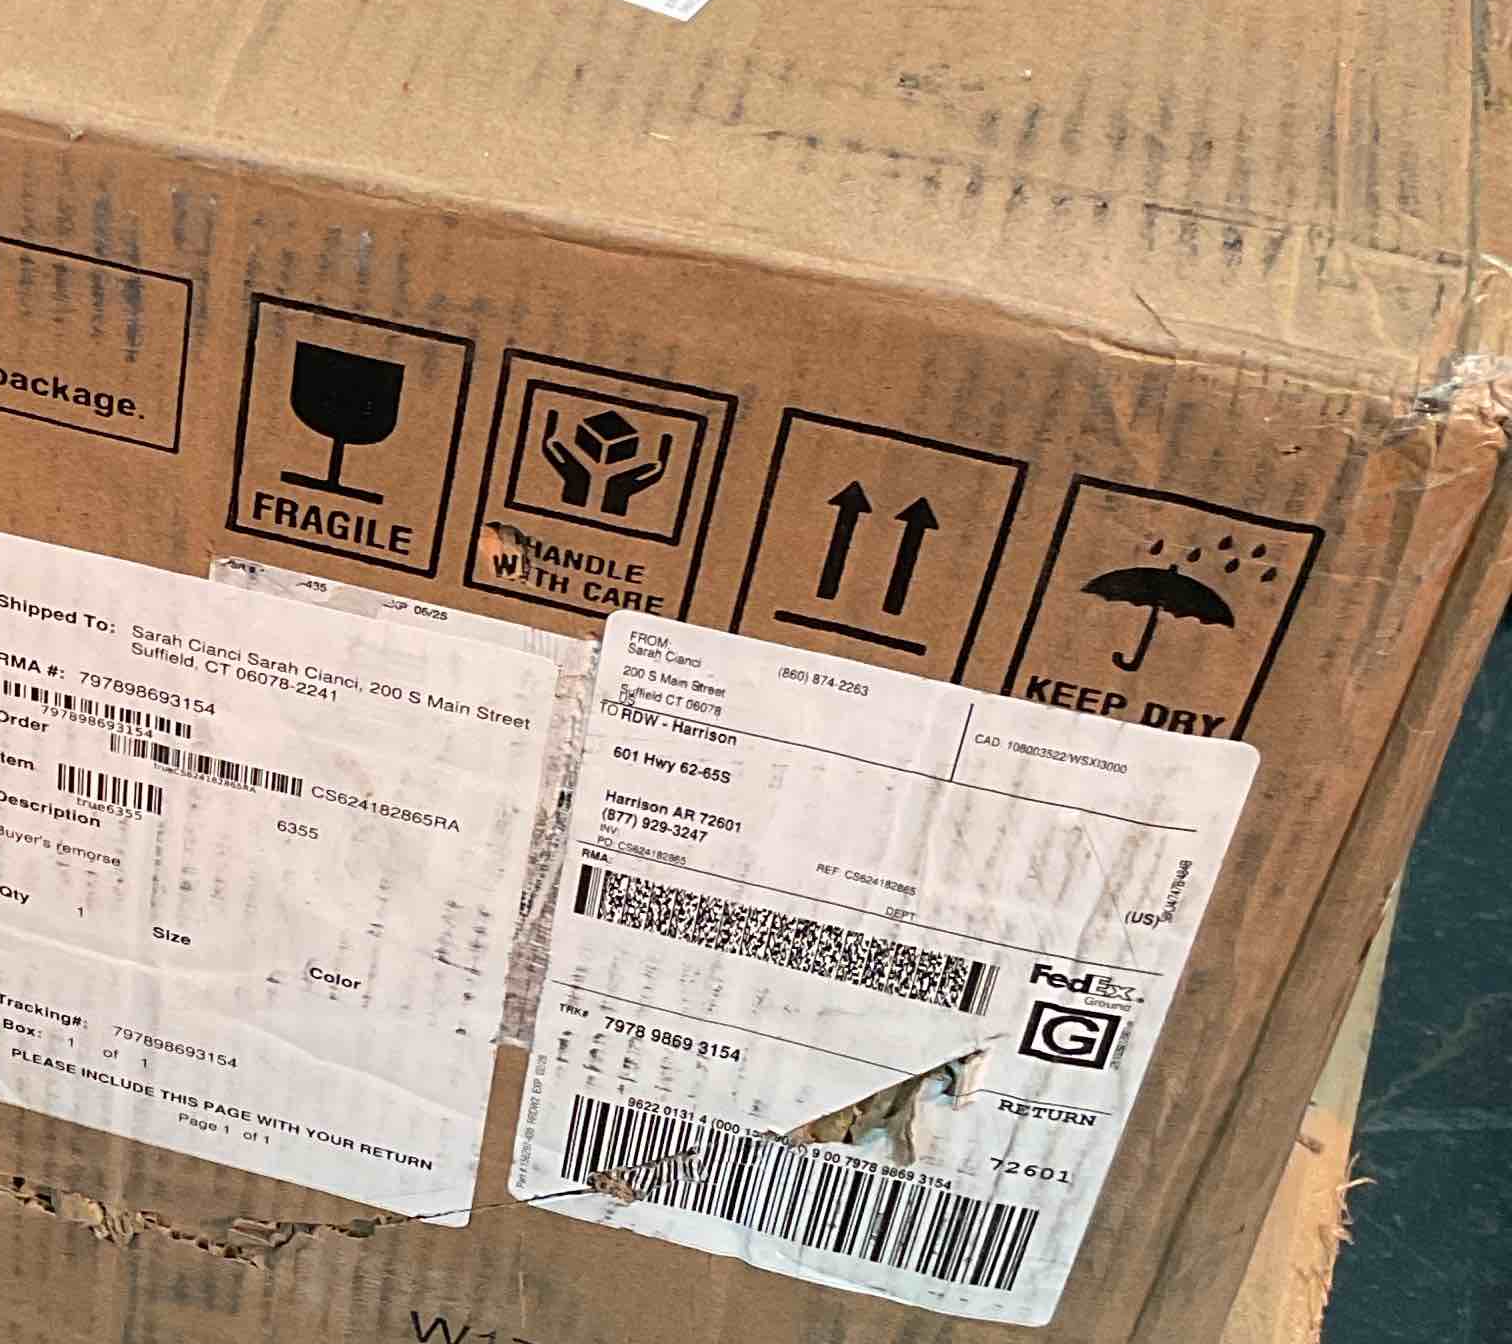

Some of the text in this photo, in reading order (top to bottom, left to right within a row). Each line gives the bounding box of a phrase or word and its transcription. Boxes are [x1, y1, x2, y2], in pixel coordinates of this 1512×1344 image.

[252, 490, 414, 557] FRAGILE
[525, 535, 648, 586] HANDLE
[582, 580, 666, 618] CARE
[83, 613, 117, 635] To:
[131, 624, 183, 649] Sarah
[188, 638, 242, 663] Cianci
[247, 652, 299, 677] Sarah
[304, 665, 363, 693] Cianci,
[369, 681, 403, 701] 200
[408, 690, 422, 705] S
[426, 694, 471, 717] Main
[476, 705, 532, 731] Street
[130, 641, 339, 703] Suffield, CT 06078-2241
[627, 642, 663, 663] Sarah
[46, 663, 66, 680] #:
[79, 671, 217, 717] 797898693154
[622, 664, 646, 681] 200
[647, 669, 658, 683] S
[777, 665, 811, 687] (860)
[664, 691, 684, 706] CT
[1024, 674, 1227, 737] KEEP DRY
[39, 703, 155, 740] 797898693154
[599, 701, 619, 718] TO
[619, 705, 661, 727] RDW
[672, 718, 739, 747] Harrison
[613, 745, 732, 785] 601 Hwy 62-65S
[310, 784, 462, 834] CS624182865RA
[600, 807, 639, 830] (877)
[640, 815, 709, 844] 929-3247
[604, 788, 744, 834] Harrison AR 72601
[276, 819, 321, 841] 6355
[55, 839, 123, 869] remorse
[77, 905, 86, 918] 1
[1124, 910, 1161, 929] (US)
[151, 925, 193, 947] Size
[308, 965, 364, 991] Color
[1029, 962, 1138, 1005] FedEx
[1, 1018, 149, 1070] Box: 1 of 1
[111, 1025, 239, 1070] 797898693154
[603, 1015, 647, 1040] 7978
[650, 1027, 694, 1052] 9869
[696, 1039, 742, 1063] 3154
[1041, 1013, 1100, 1057] G
[11, 1047, 434, 1172] PLEASE INCLUDE THIS PAGE WITH YOUR RETURN
[177, 1112, 271, 1145] Page 1 of 1
[998, 1098, 1097, 1127] RETURN
[627, 1095, 661, 1115] 9622
[662, 1104, 696, 1123] 0131
[698, 1113, 708, 1125] 4
[845, 1154, 879, 1175] 7978
[880, 1164, 916, 1183] 9869
[918, 1174, 954, 1192] 3154
[988, 1156, 1073, 1184] 72601
